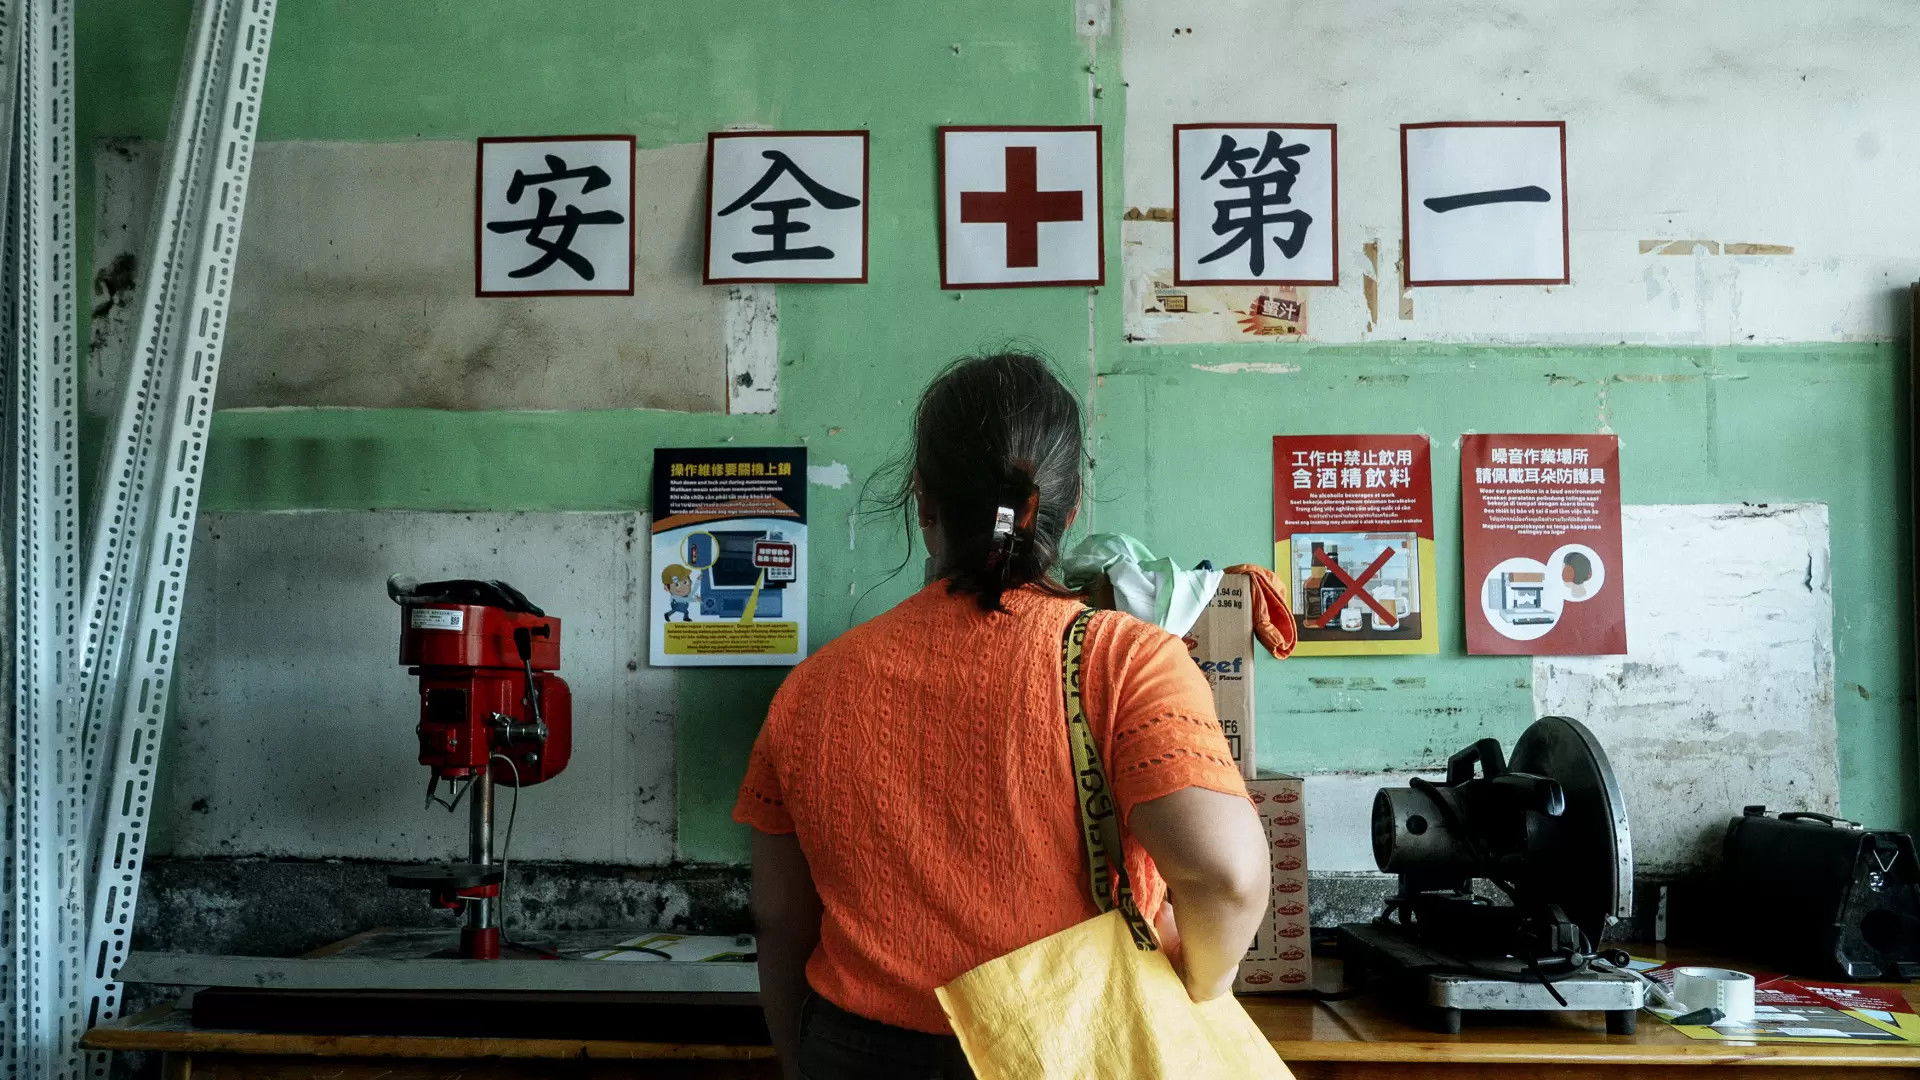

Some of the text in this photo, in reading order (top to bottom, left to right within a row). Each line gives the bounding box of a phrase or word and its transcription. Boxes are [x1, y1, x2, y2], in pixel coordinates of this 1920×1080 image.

[487, 131, 1550, 281] 安 全 第 一
[1262, 299, 1297, 321] 蜜汁
[1291, 449, 1412, 466] 工作中禁止飲用
[1491, 447, 1589, 465] 噪音作業場所
[671, 462, 792, 477] 操作維修要關機上鎖
[1475, 468, 1606, 484] 請佩戴耳朵防護具
[1291, 467, 1411, 489] 含酒精飲料
[1506, 488, 1538, 496] protection
[1232, 588, 1242, 597] oz)
[1217, 600, 1232, 608] 3.96
[1234, 600, 1242, 609] kg
[1195, 657, 1243, 673] eef
